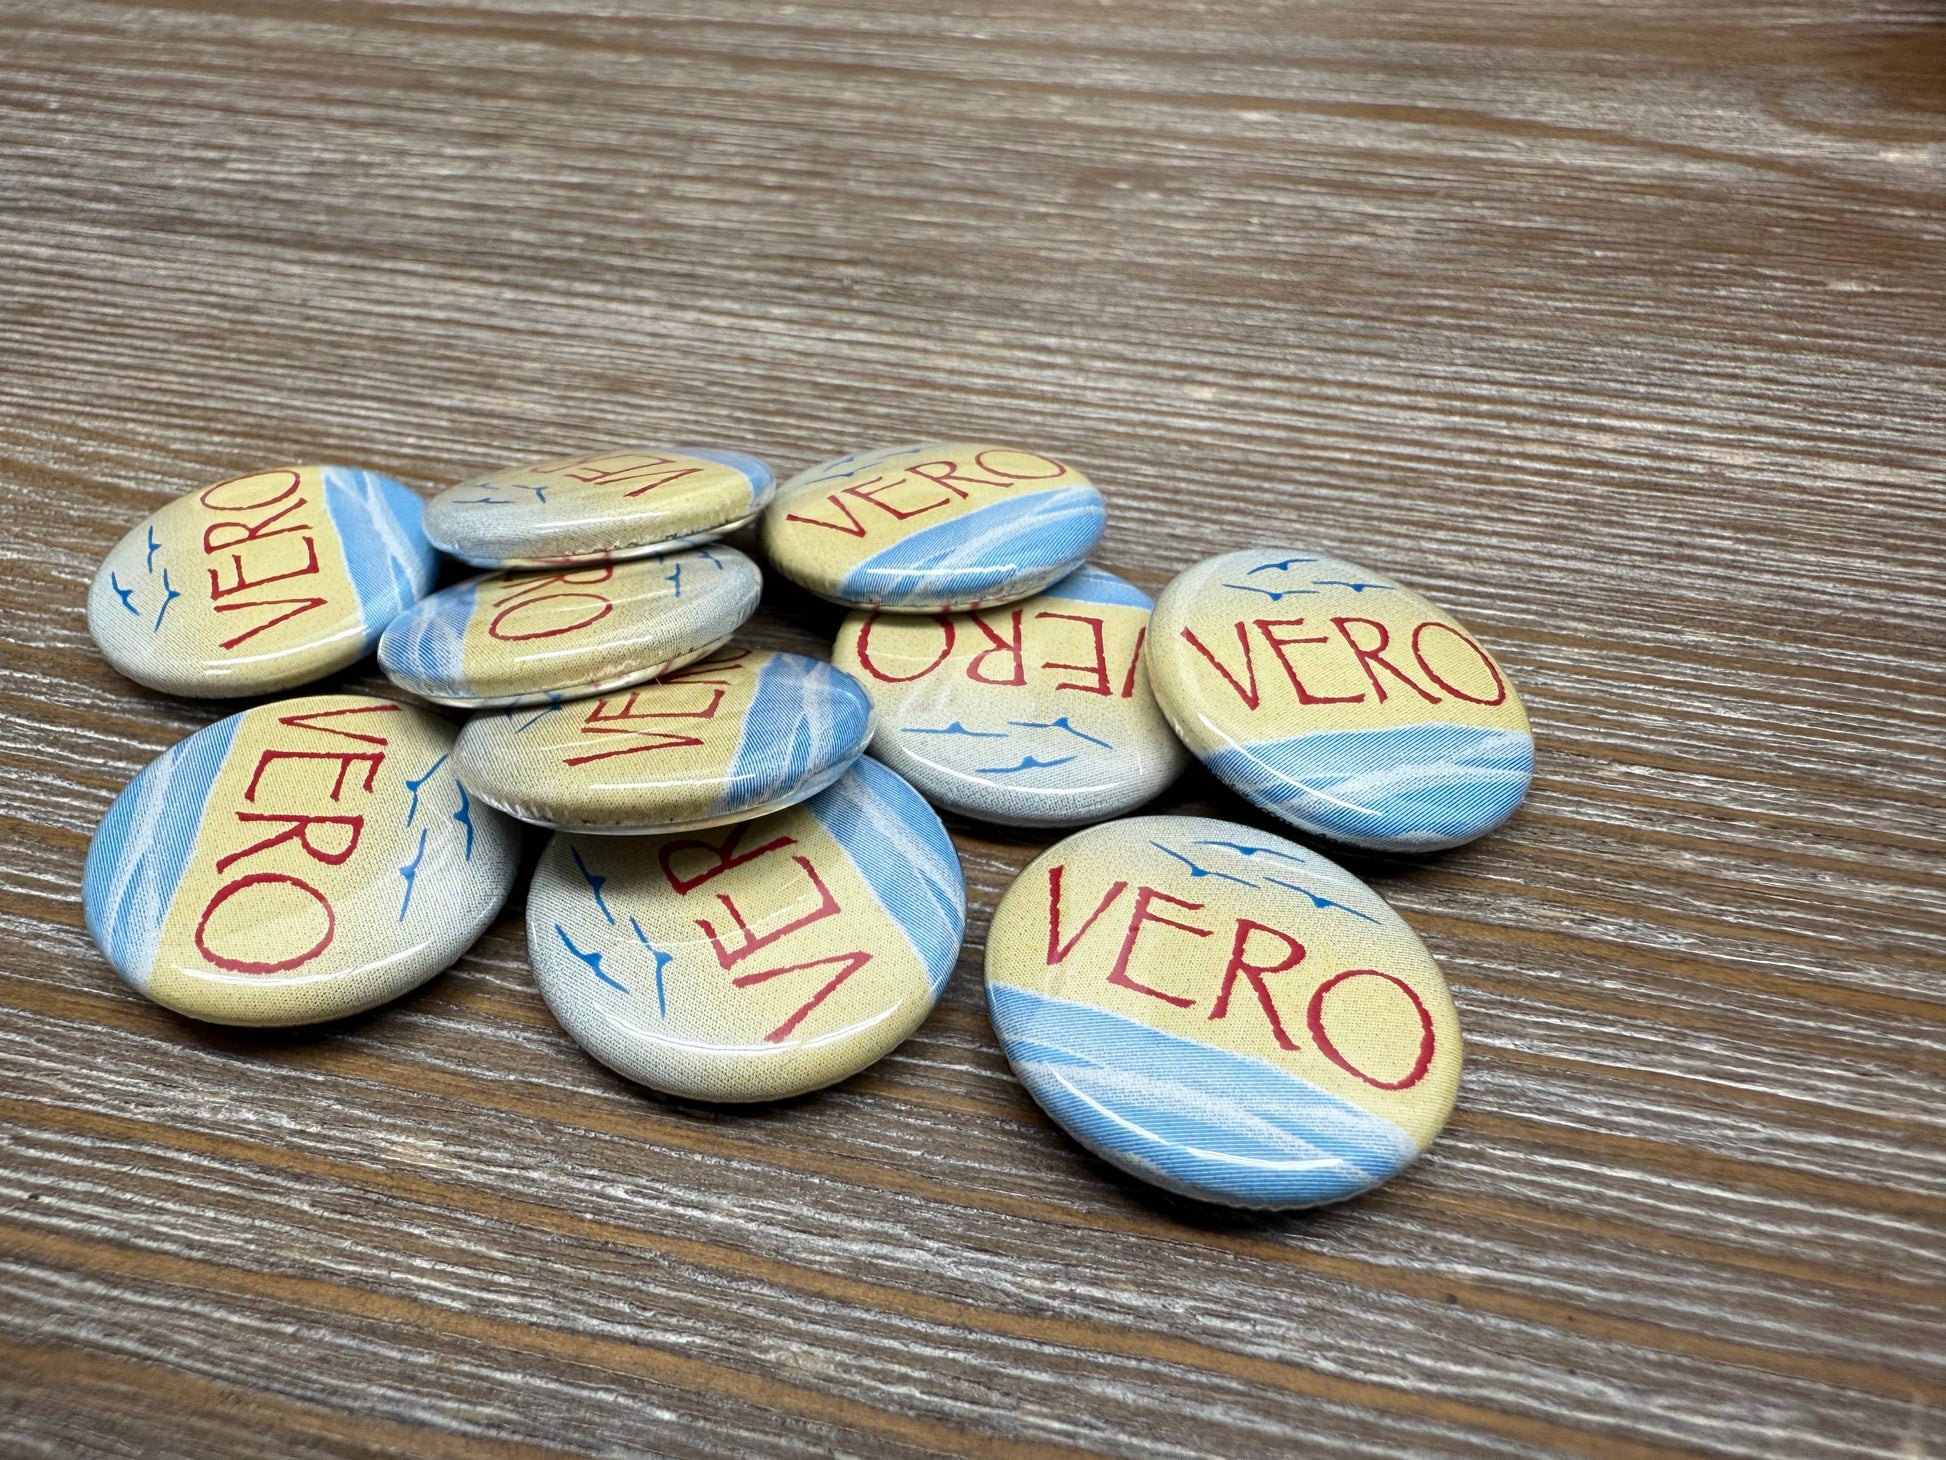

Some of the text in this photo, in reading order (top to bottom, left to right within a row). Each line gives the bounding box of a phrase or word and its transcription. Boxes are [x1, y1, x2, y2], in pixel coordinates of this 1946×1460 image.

[200, 467, 328, 650] VERO
[786, 449, 1066, 538] VERO
[1180, 616, 1506, 711] VERO
[195, 704, 401, 975] VERO
[658, 822, 873, 1043] VER
[1046, 865, 1436, 1091] VERO
